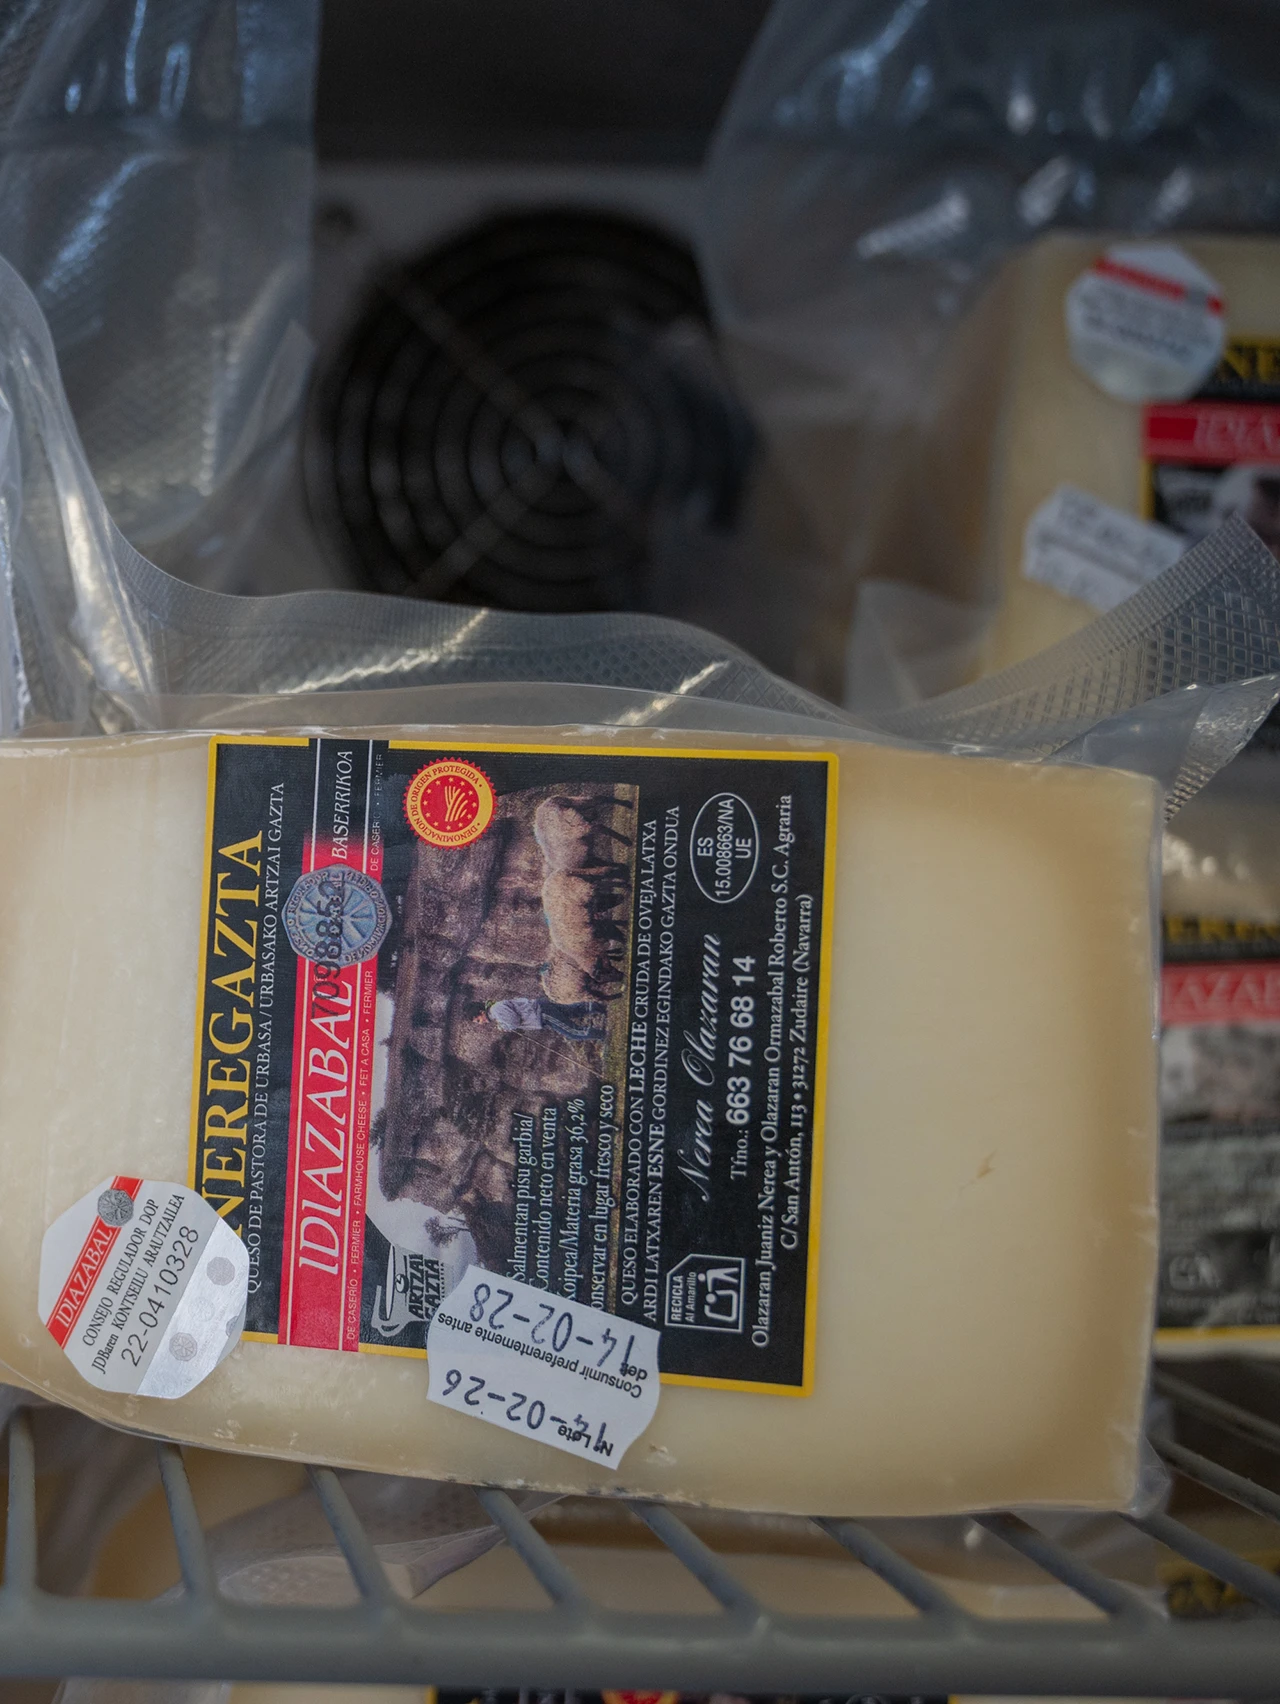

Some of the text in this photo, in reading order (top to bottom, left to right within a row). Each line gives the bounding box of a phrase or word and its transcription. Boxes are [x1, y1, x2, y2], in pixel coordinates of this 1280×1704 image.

[331, 749, 353, 859] BASERRIKOA
[410, 764, 479, 842] DENOMINACION DE ORIGEN PROTEGIDA
[696, 836, 713, 856] ES
[714, 797, 734, 896] 15.008663/NA
[734, 837, 751, 858] UE
[199, 827, 264, 1242] NEREGAZTA
[246, 781, 284, 1293] QUESO DE PASTORA DE URBASA URBASAKO ARTZAI GAZTA
[345, 857, 379, 1339] DE CASERÍO FERMIER FARMHOUSE CHEESE FET CASA FERMIER DE
[620, 818, 657, 1305] QUESO ELABORADO CON LECHE CRUDA DE OVEJA LATXA
[643, 805, 679, 1321] ARDI LATXAREN ESNE GORDINEZ EGINDAKO GAZTA ONDUA
[675, 931, 723, 1201] Nerea Olazaran
[725, 955, 756, 1180] Tfno.: 663 76 68 14
[750, 794, 796, 1347] Olazaran Juaniz Nerea y Olazaran Ormazabal Roberto S.C. Agraria
[779, 893, 814, 1249] C/ San Antón, 113 31272 Zudaire (Navarra)
[506, 1112, 538, 1280] Salmentan pisu garbia/
[529, 1107, 557, 1290] Contenido neto en venta
[566, 1098, 589, 1185] grasa 36,2%
[589, 1084, 620, 1241] en lugar fresco y seco
[53, 1224, 114, 1328] IDIAZABAL
[80, 1197, 160, 1348] CONSEJO REGULADOR DOP
[90, 1191, 185, 1374] JDBaren KONTSEILU ARAUTZAILEA
[118, 1223, 201, 1367] 22-0410328
[406, 1253, 426, 1319] ARTZAI
[462, 1280, 638, 1376] 14-02-28
[670, 1275, 683, 1320] RECICLA
[684, 1271, 696, 1322] Al Amarillo
[435, 1311, 643, 1399] Consumir preferentemente antes
